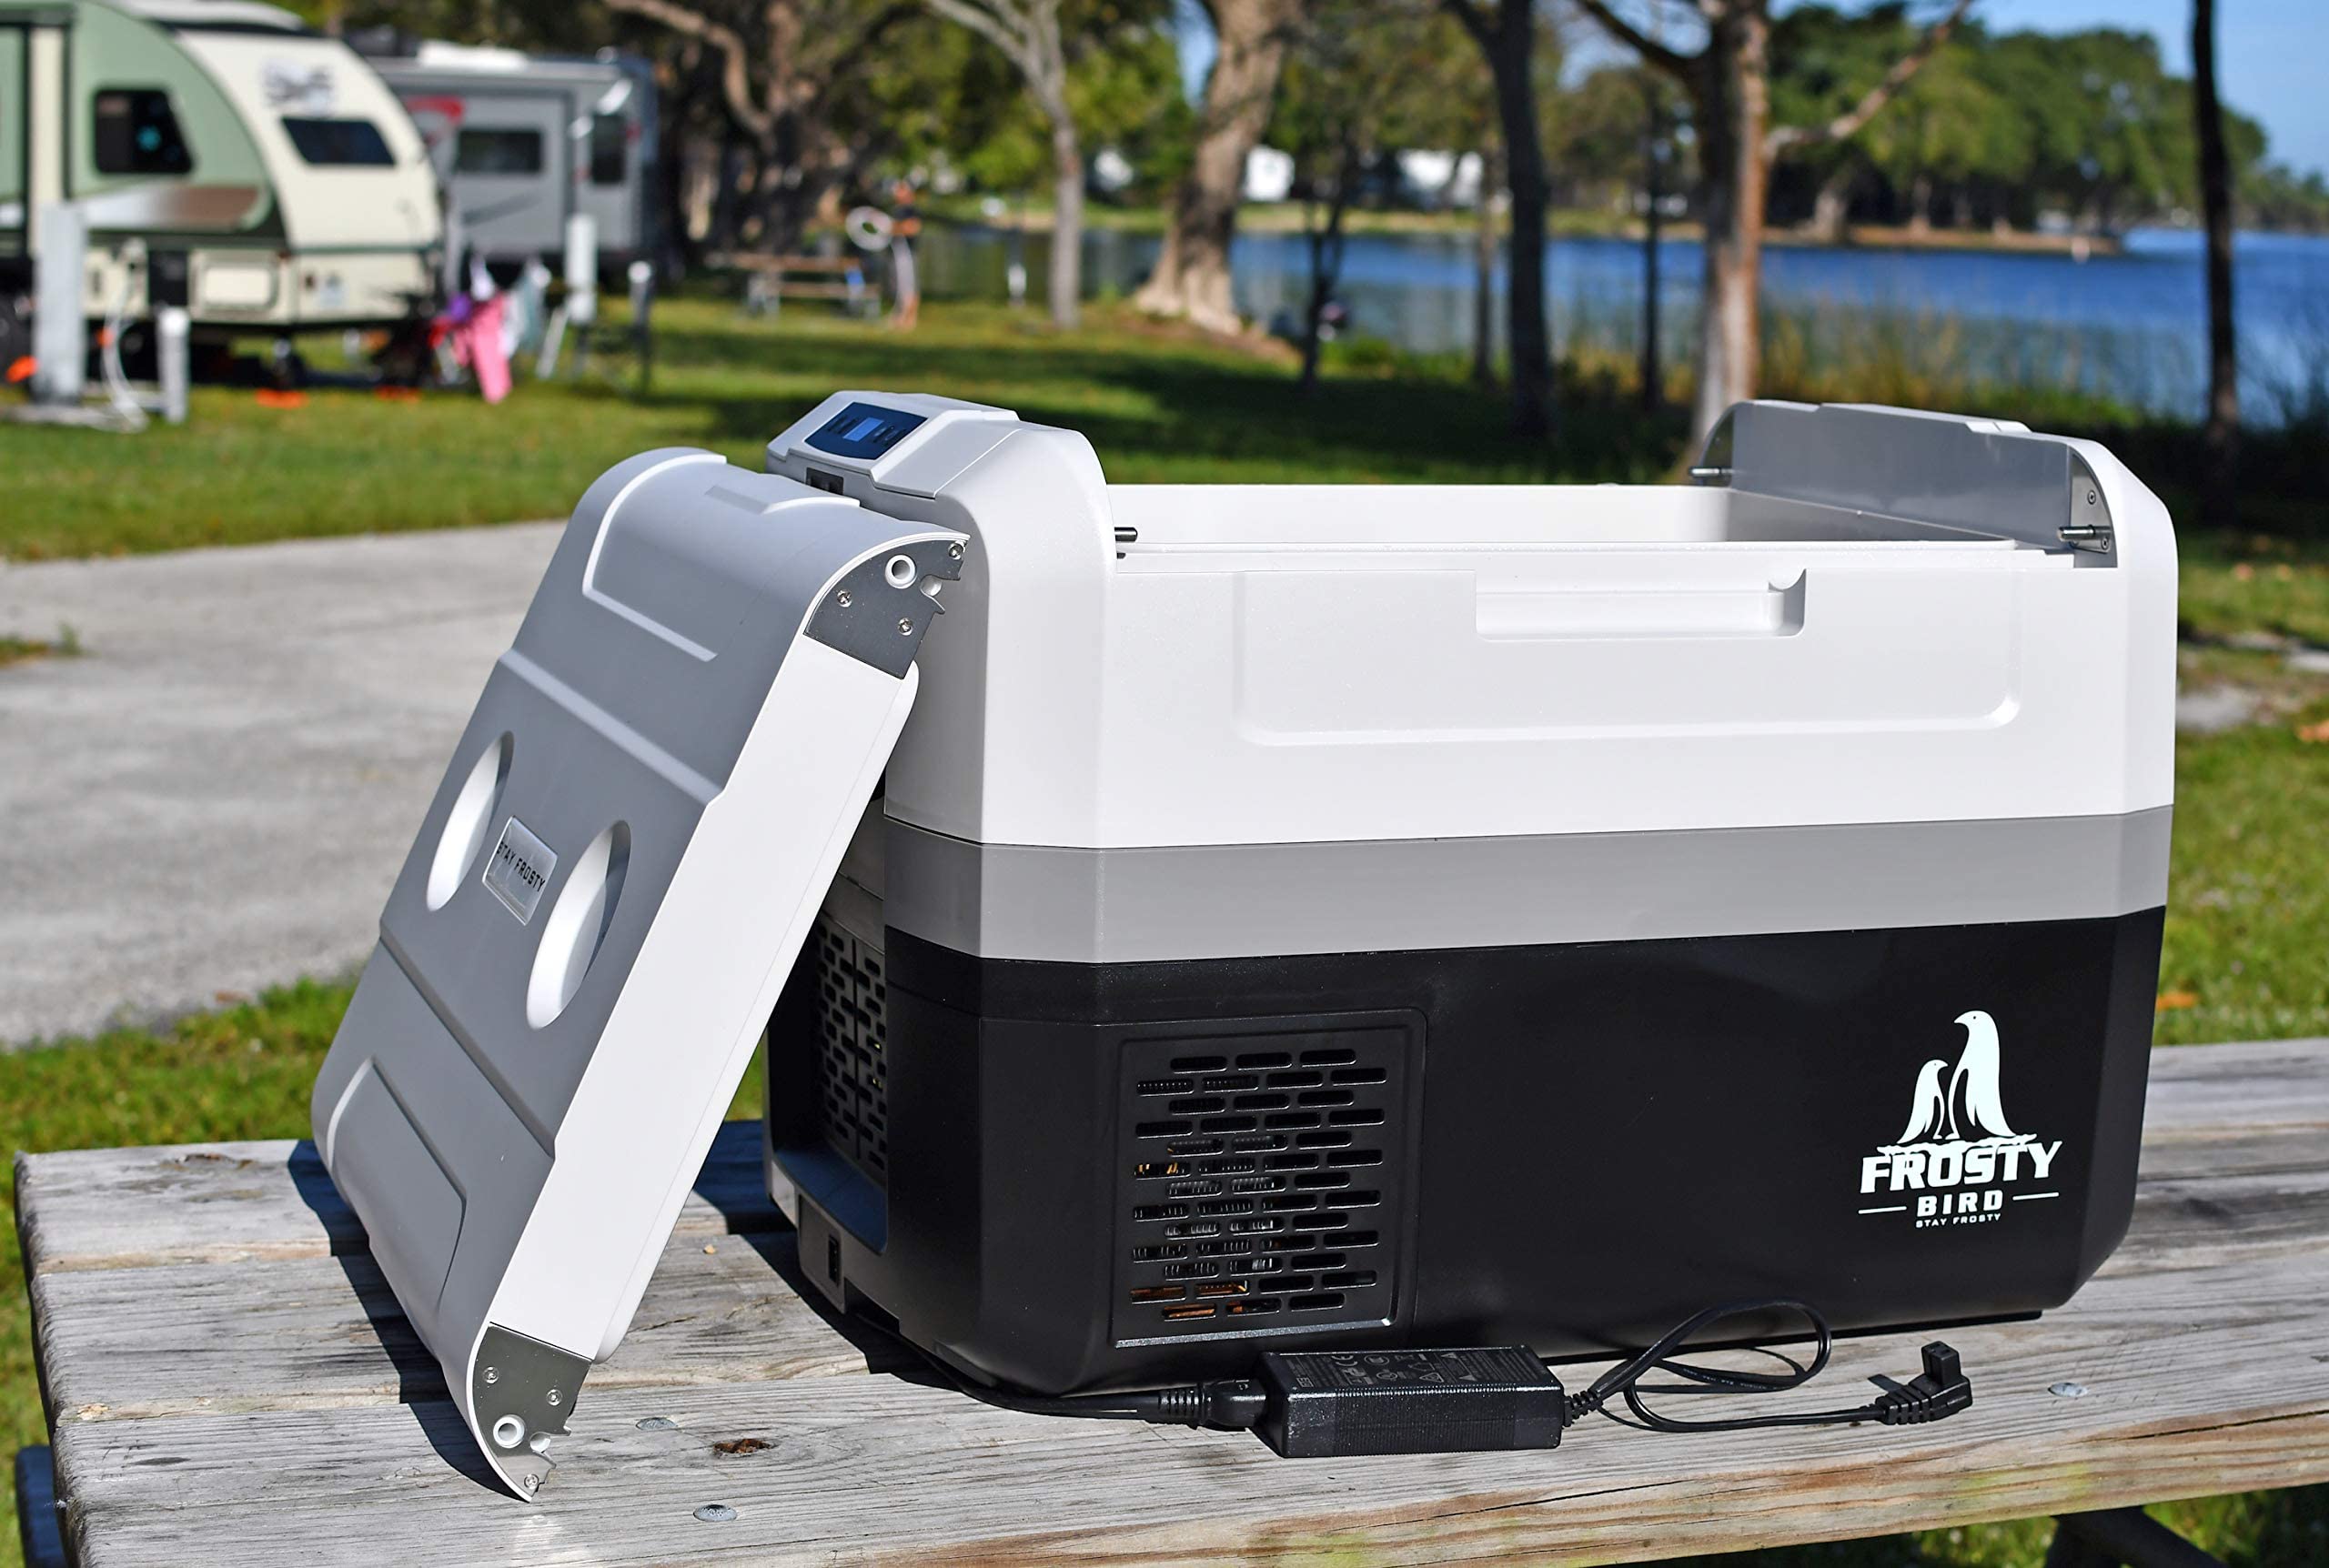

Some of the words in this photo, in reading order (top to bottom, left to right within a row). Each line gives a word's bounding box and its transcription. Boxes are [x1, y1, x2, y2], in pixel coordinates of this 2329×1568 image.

[514, 858, 546, 892] FROSTY
[1860, 1141, 2062, 1193] FROSTY
[1917, 1190, 2003, 1217] BIRD
[1915, 1219, 1947, 1229] STAY
[1952, 1213, 2001, 1225] FROSTY
